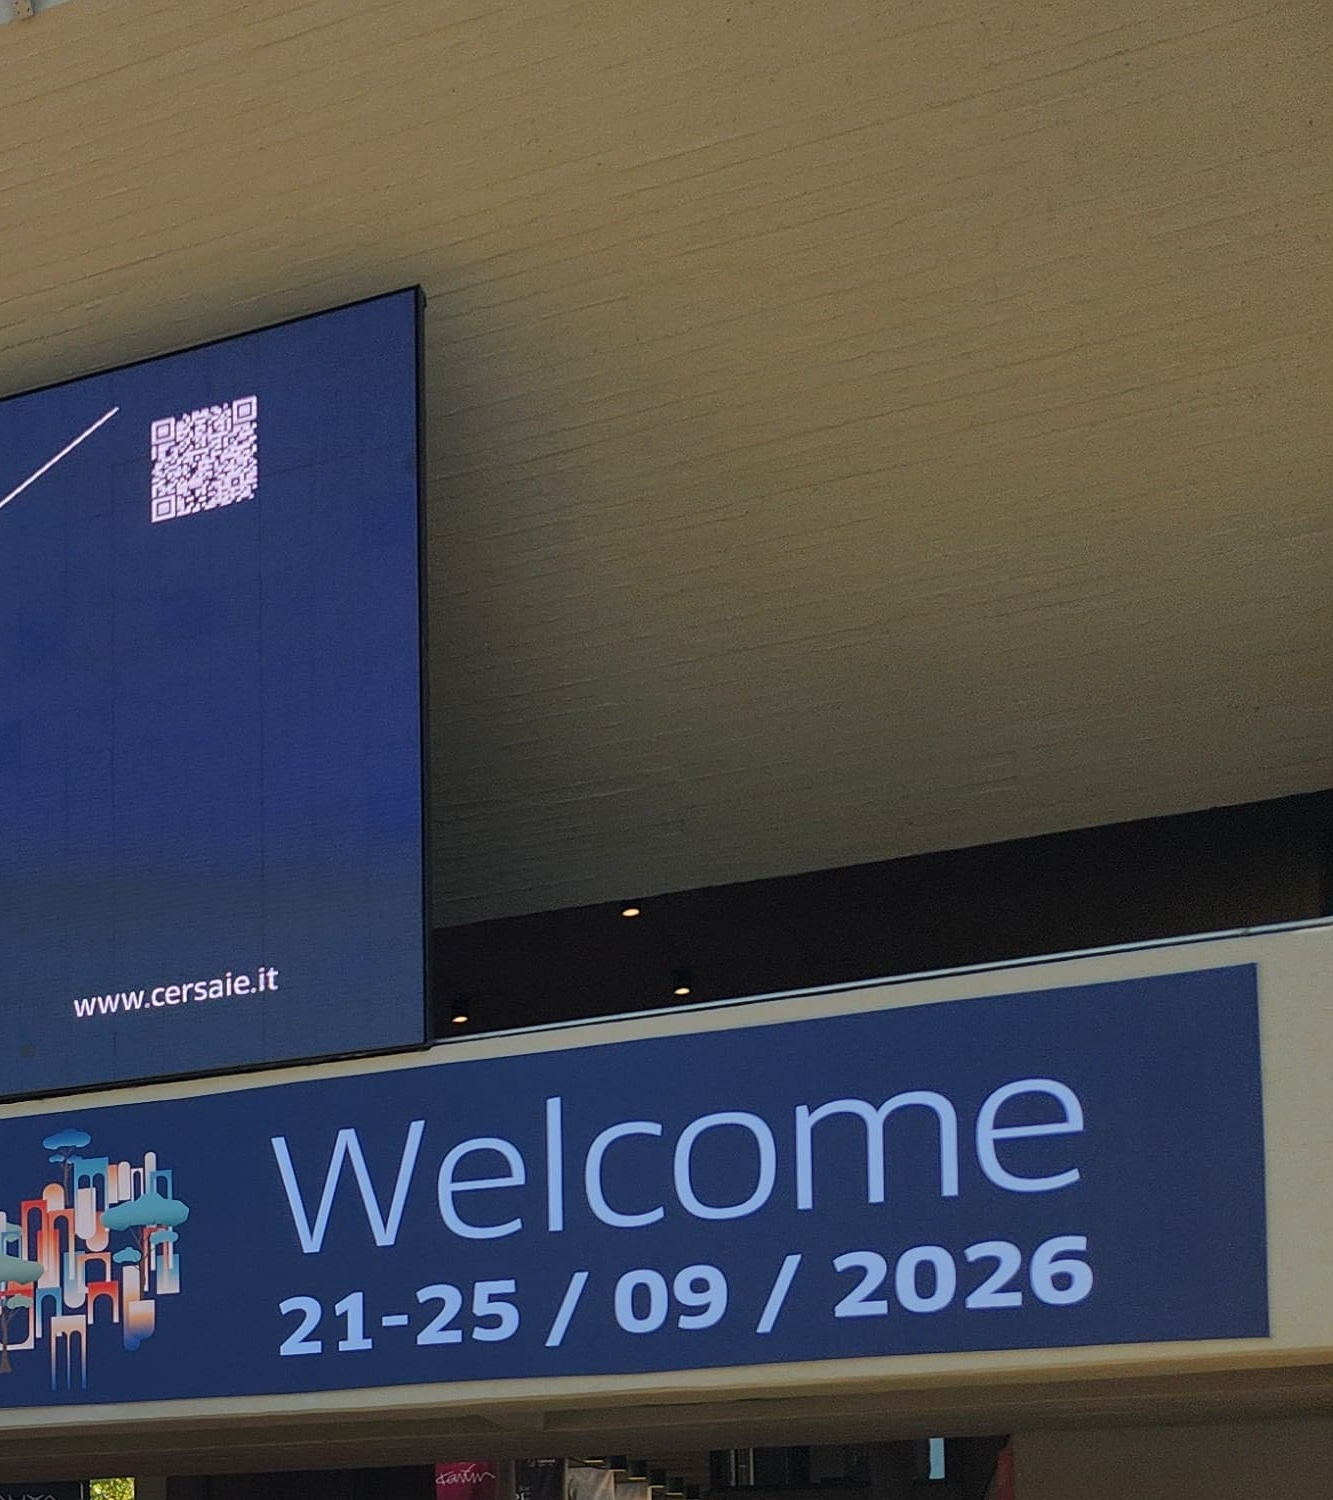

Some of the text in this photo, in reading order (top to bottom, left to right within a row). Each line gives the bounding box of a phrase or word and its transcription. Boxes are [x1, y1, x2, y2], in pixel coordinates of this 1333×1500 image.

[73, 966, 279, 1018] www.cersaie.it
[271, 1077, 1086, 1254] Welcome
[278, 1235, 1095, 1357] 21-25 / 09 / 2026
